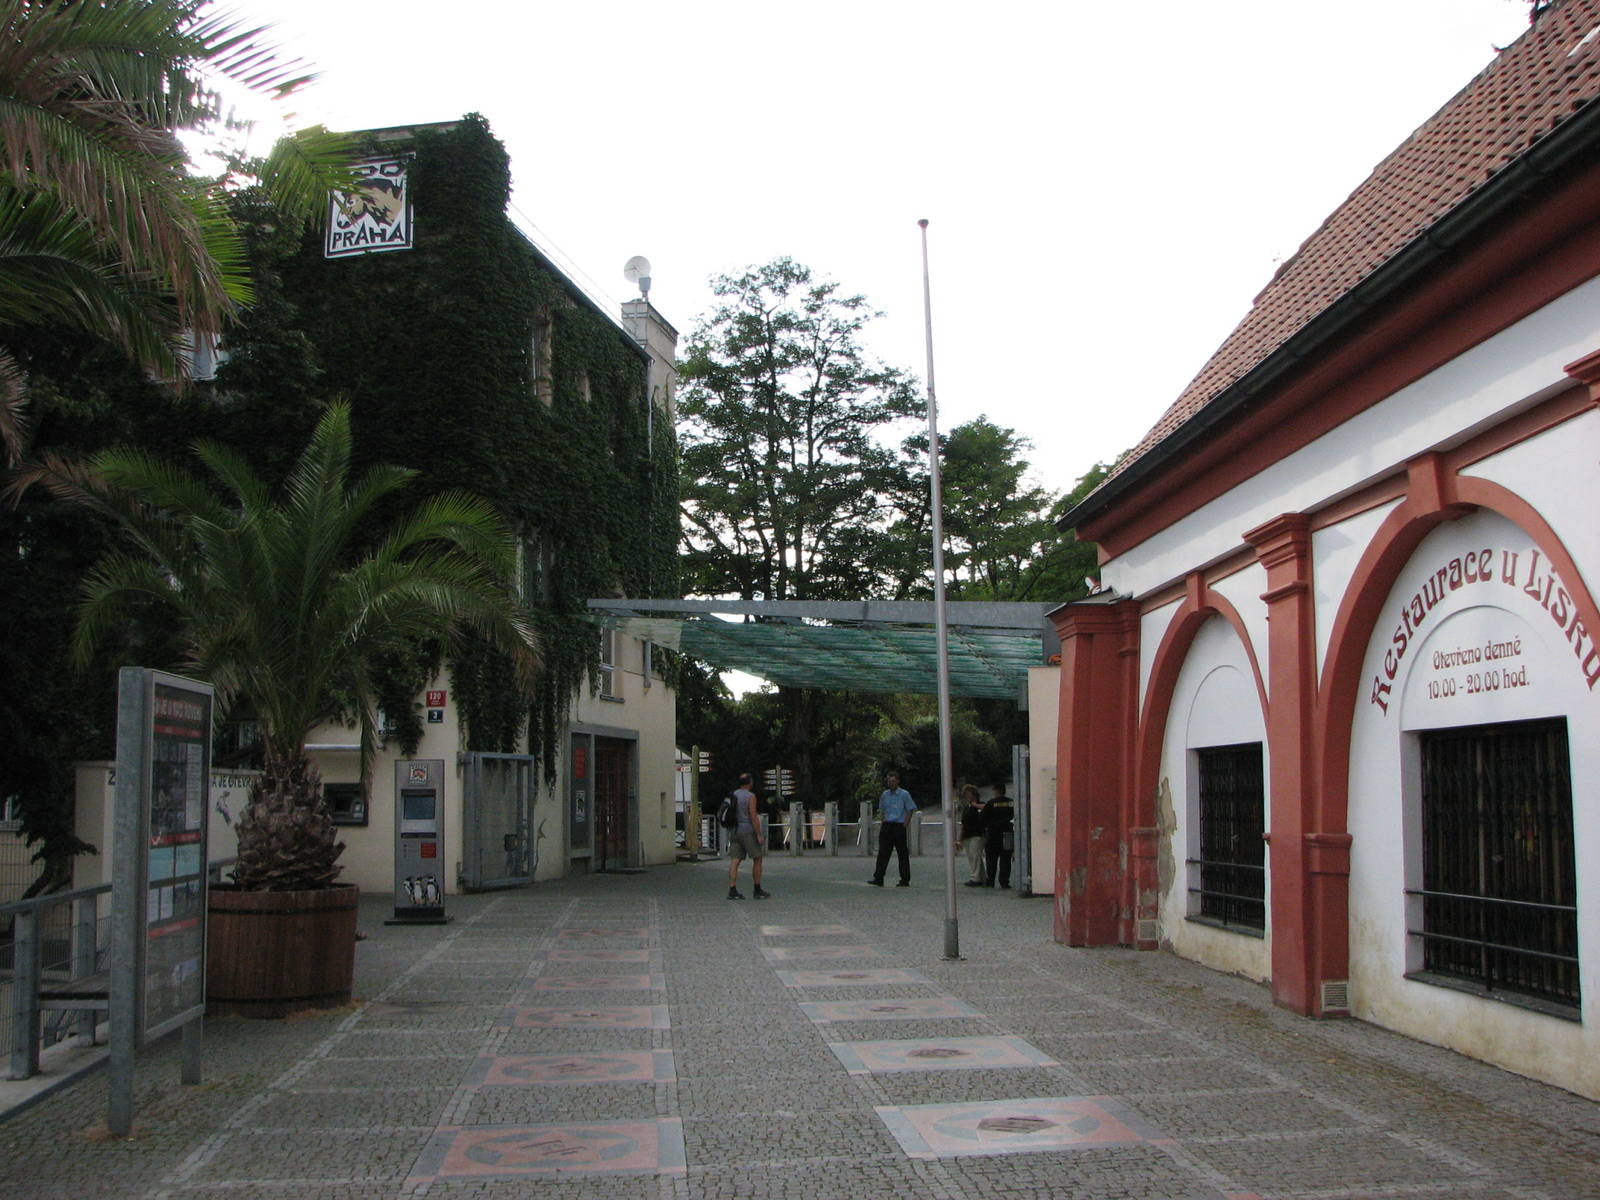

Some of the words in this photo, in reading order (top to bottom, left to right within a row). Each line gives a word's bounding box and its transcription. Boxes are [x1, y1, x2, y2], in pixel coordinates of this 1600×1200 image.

[332, 221, 405, 250] PRAHA
[1371, 548, 1493, 716] Restaurace
[1433, 646, 1481, 671] Otevřeno
[430, 692, 442, 700] 120
[1428, 677, 1456, 700] 10.00
[1467, 671, 1499, 694] 20.00
[1503, 665, 1530, 688] hod.
